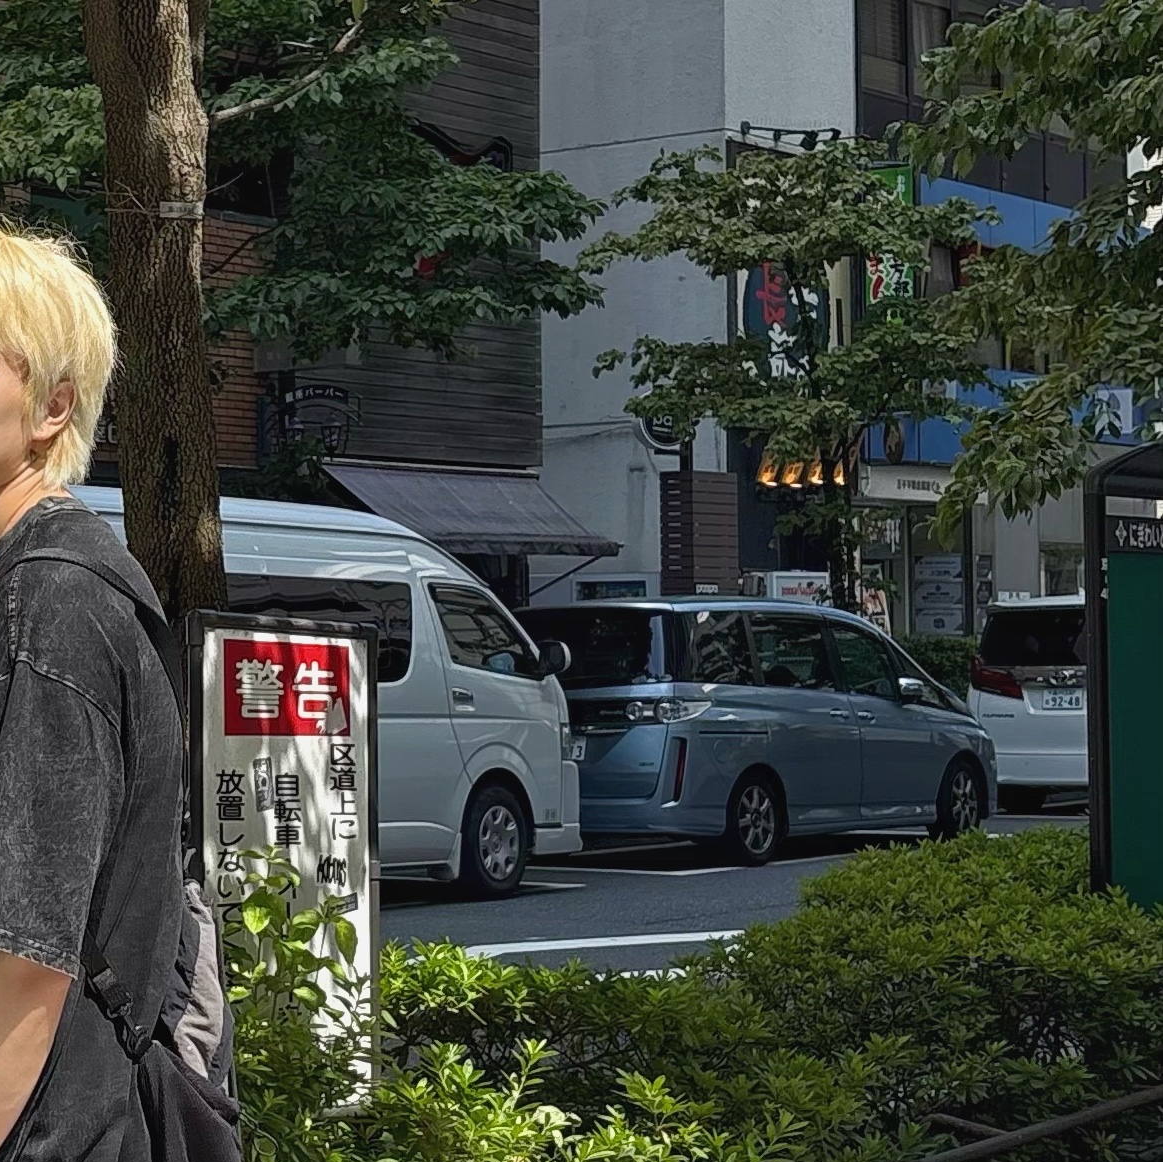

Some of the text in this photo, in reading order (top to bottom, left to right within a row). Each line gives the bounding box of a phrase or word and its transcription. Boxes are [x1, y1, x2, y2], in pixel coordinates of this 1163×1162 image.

[1129, 522, 1163, 549] にぎわい
[235, 658, 338, 721] 警告
[329, 743, 358, 841] 区道上に
